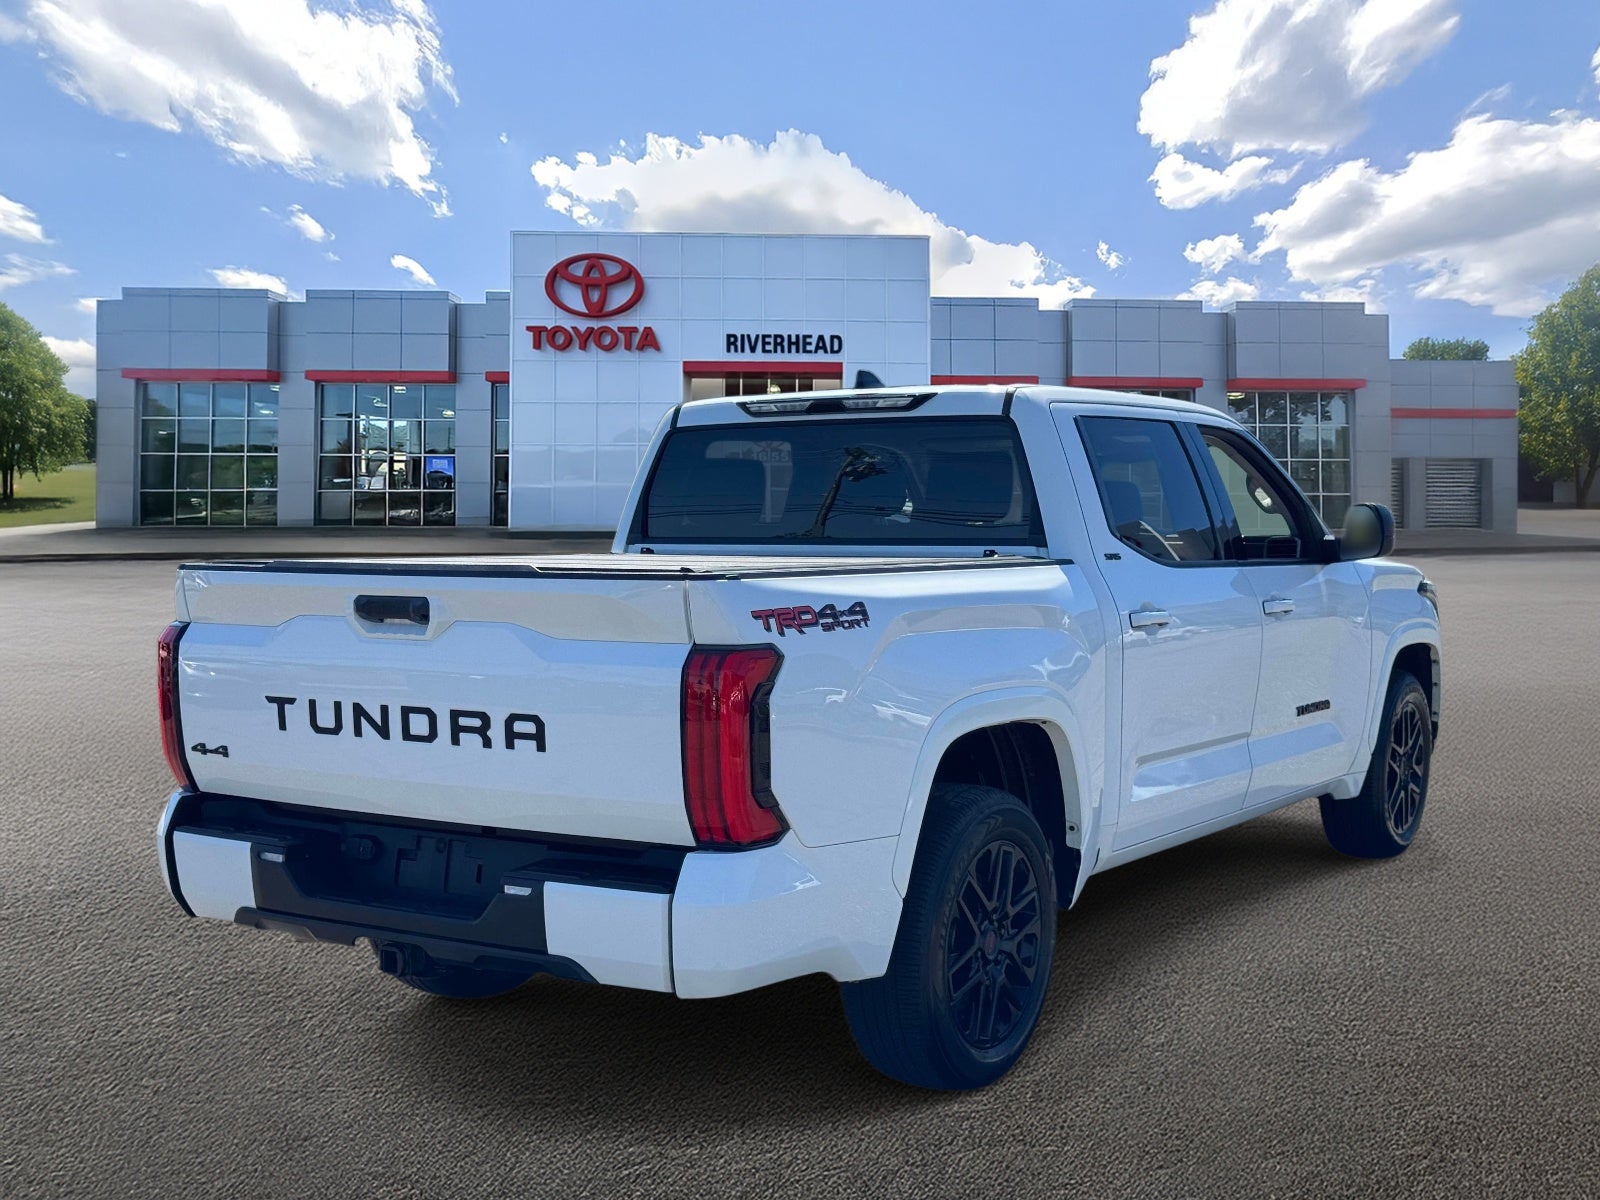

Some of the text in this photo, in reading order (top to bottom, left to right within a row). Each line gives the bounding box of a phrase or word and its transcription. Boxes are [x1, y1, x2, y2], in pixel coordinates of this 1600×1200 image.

[526, 325, 661, 352] TOYOTA
[725, 333, 844, 355] RIVERHEAD
[750, 605, 820, 637] TRD
[820, 618, 870, 632] SPORT
[264, 695, 547, 753] TUNDRA
